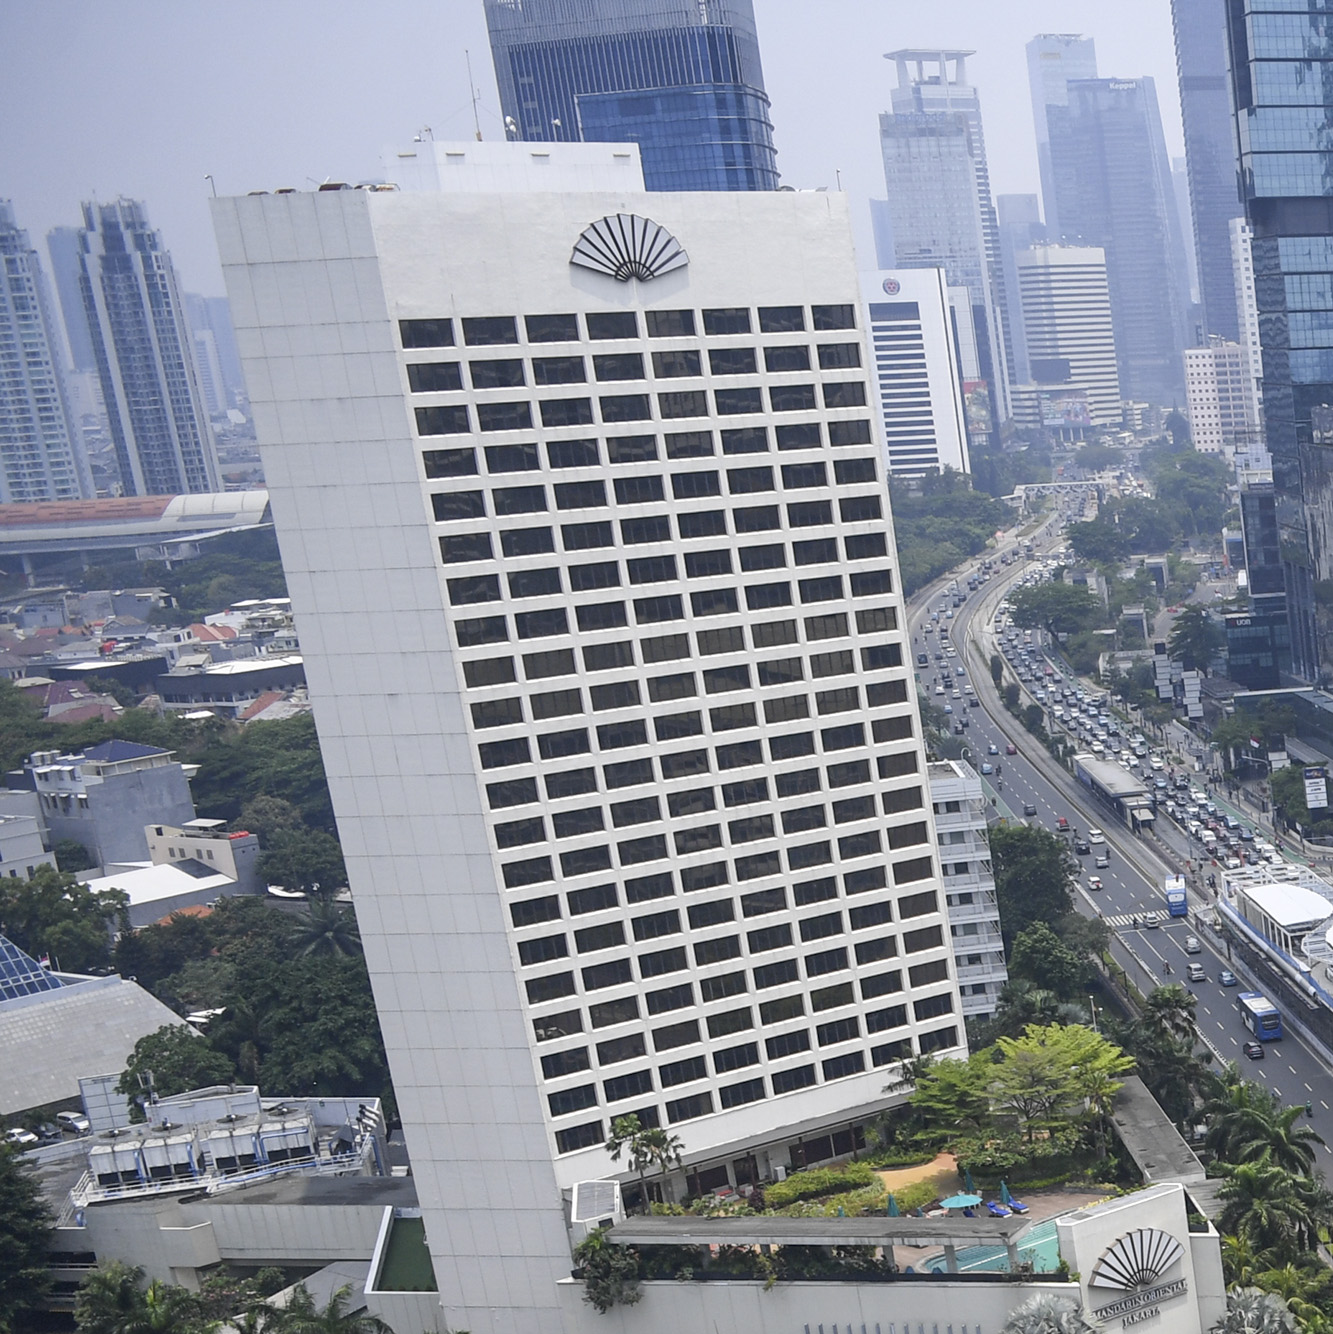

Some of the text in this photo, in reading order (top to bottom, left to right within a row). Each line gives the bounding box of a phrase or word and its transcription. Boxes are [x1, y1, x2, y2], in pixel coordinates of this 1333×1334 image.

[1091, 1280, 1188, 1319] MANDARIN ORIENTAL
[1122, 1306, 1161, 1328] JAKARTA
